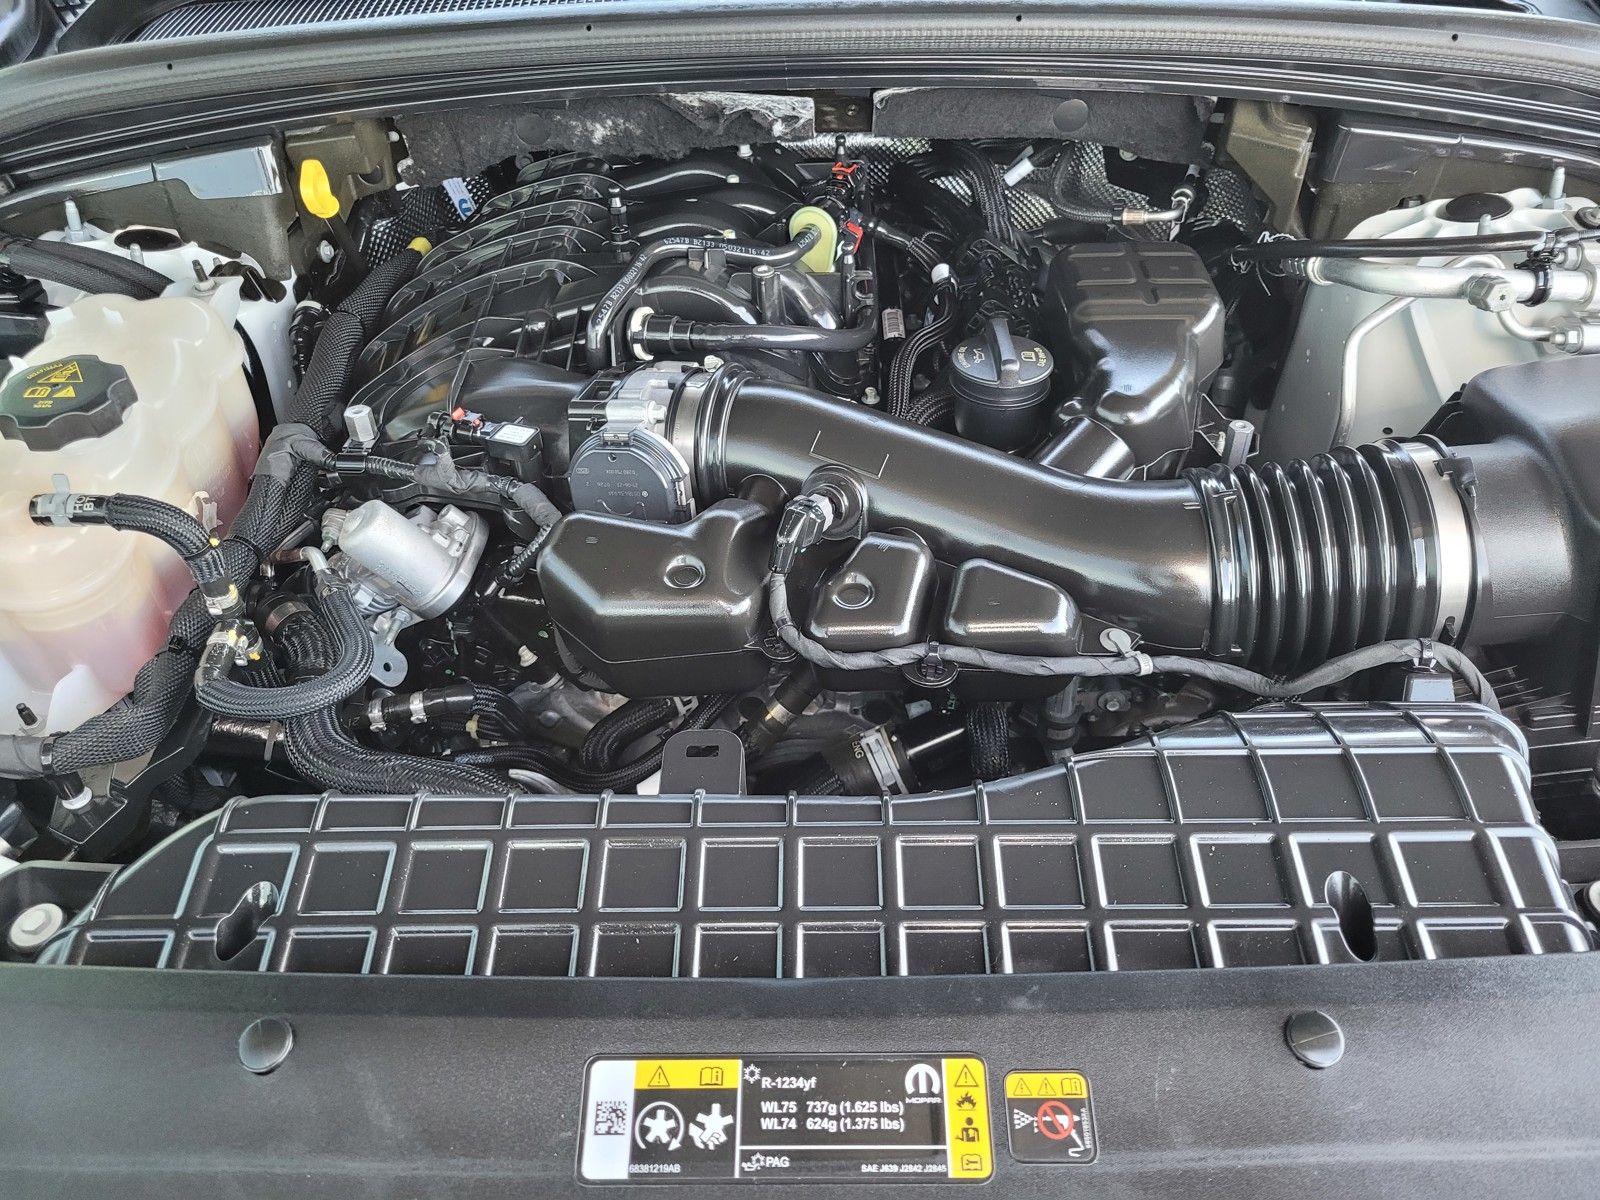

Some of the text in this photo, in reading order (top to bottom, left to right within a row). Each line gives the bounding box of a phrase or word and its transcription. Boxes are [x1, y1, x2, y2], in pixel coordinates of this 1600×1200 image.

[851, 740, 864, 758] ENG
[761, 1076, 818, 1092] R-1234yf
[761, 1101, 905, 1116] WL75 737g (1.625 lbs)
[760, 1117, 905, 1132] WL74 624g (1.375 lbs)
[628, 1163, 681, 1173] 68381219AB
[766, 1156, 790, 1168] PAG
[861, 1163, 879, 1173] SAE
